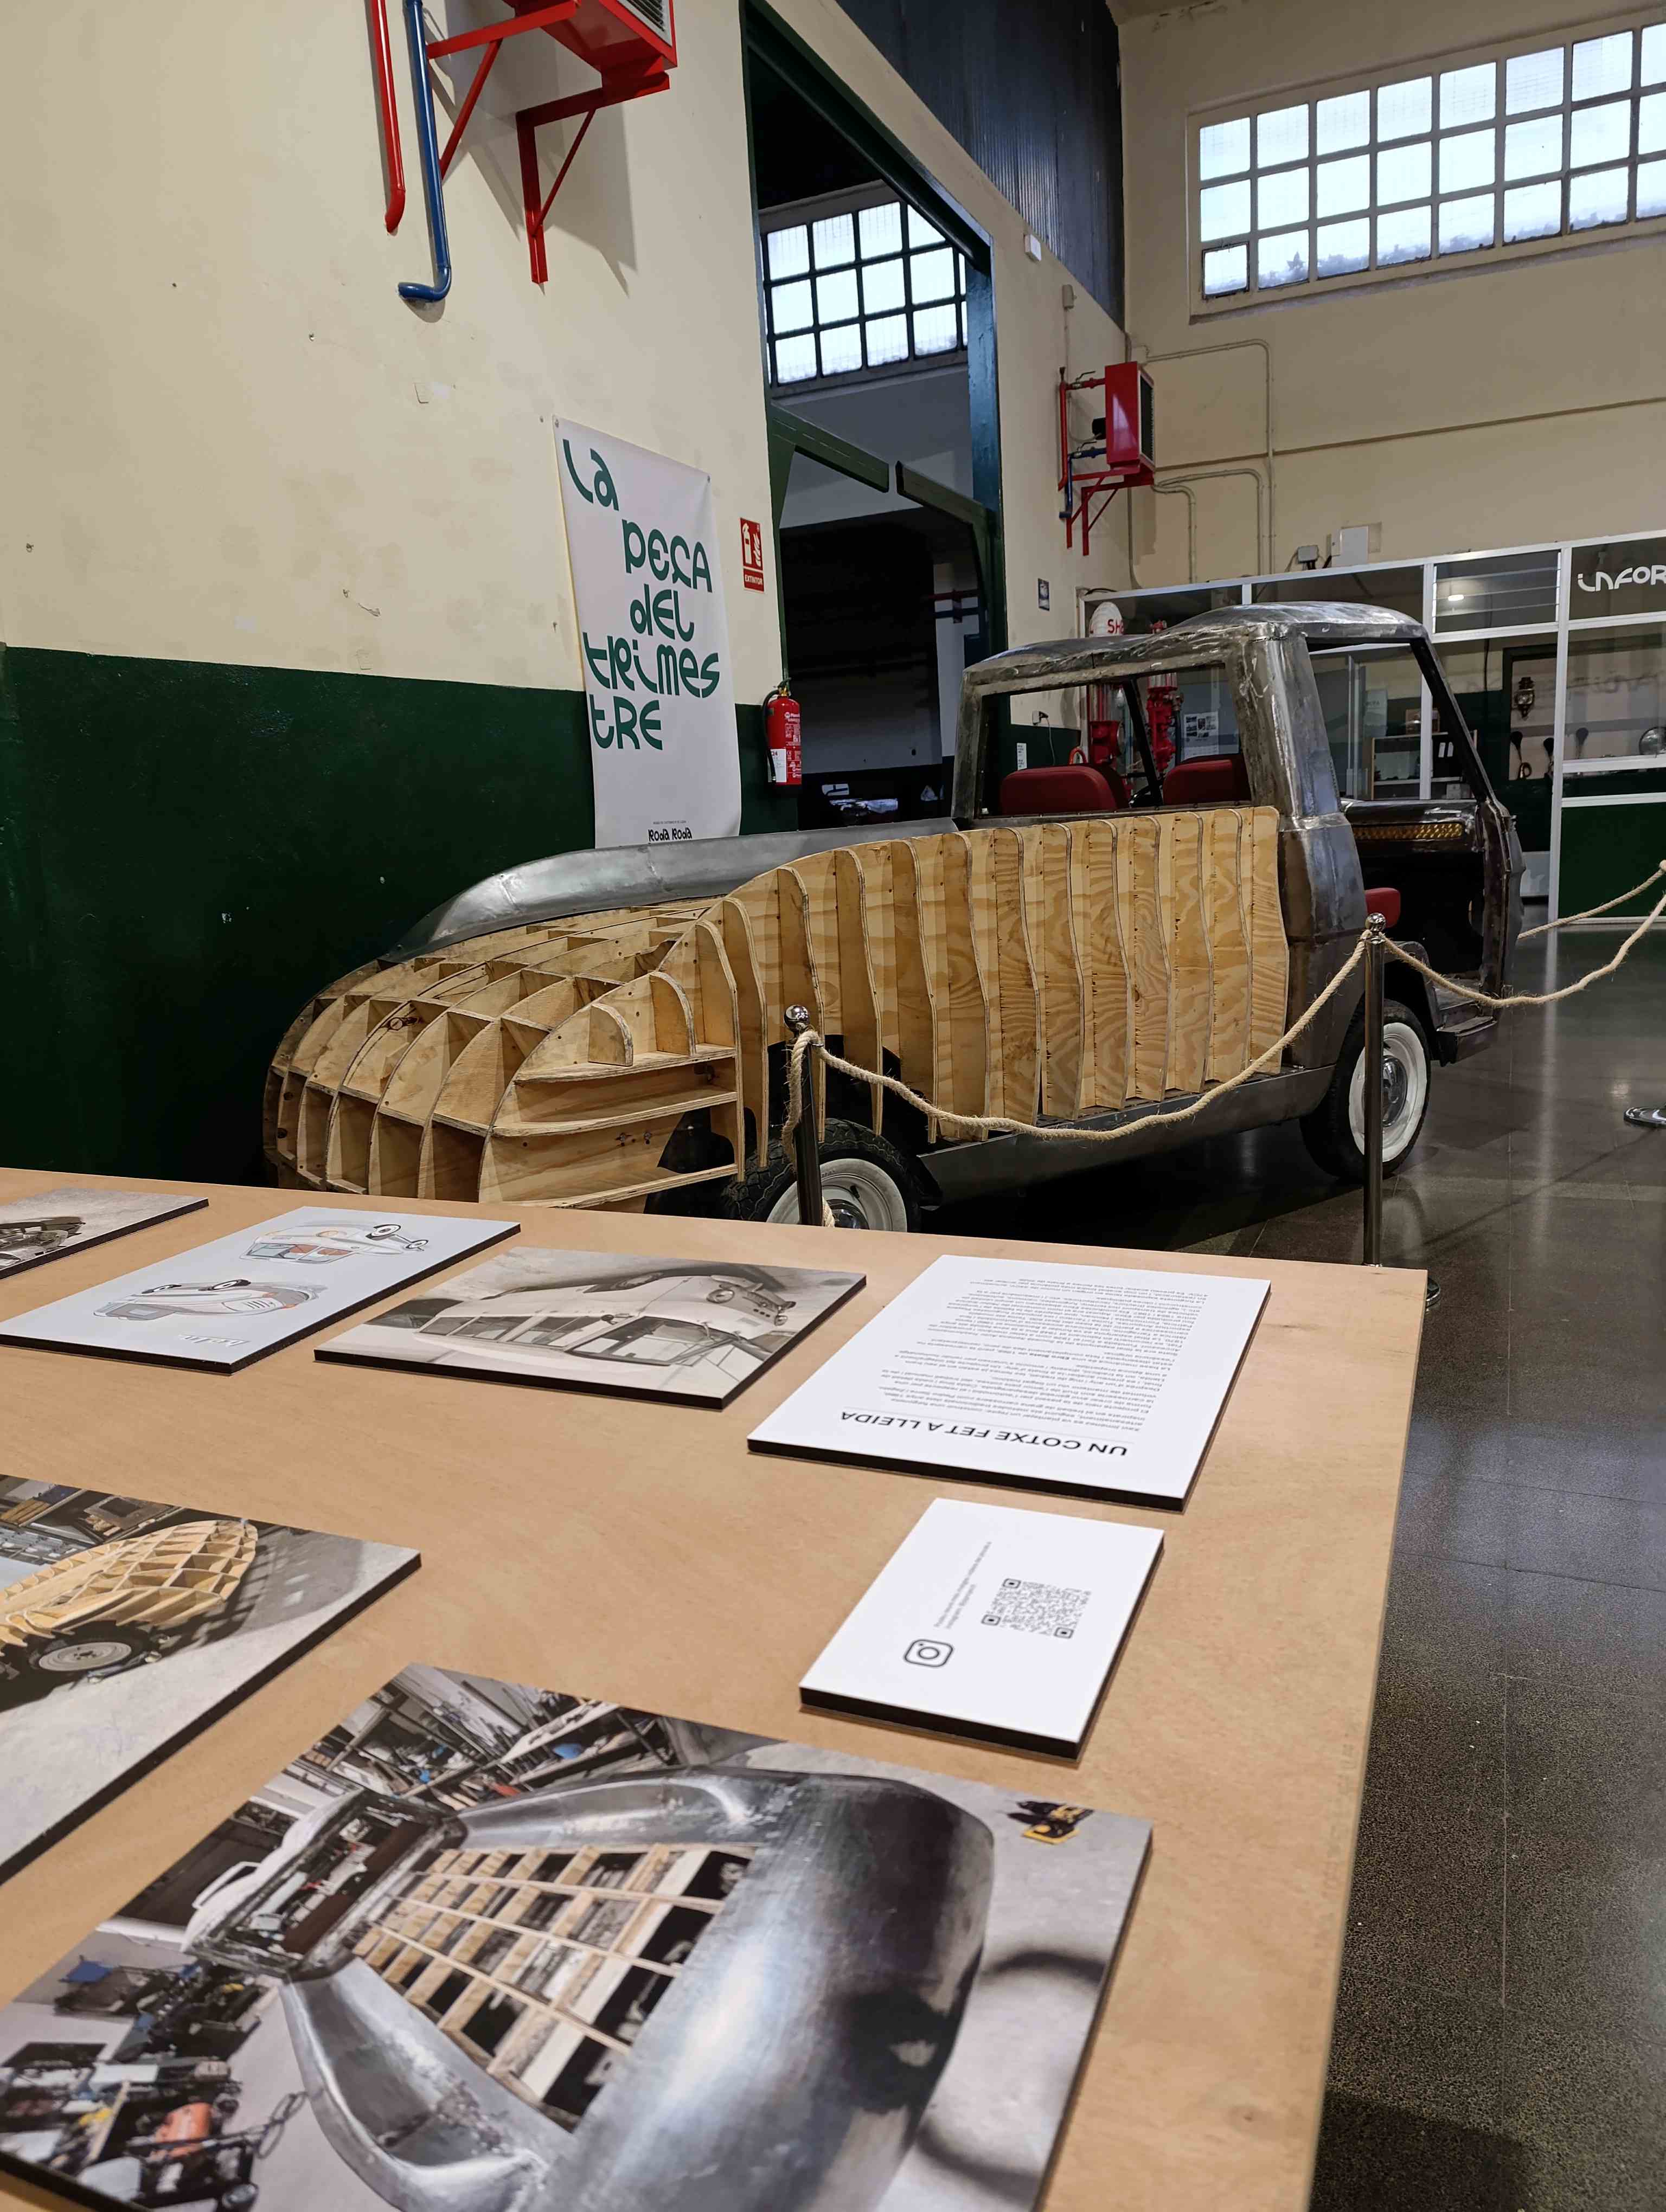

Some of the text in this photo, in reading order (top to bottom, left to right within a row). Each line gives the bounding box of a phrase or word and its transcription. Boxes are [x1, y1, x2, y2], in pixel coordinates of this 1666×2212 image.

[842, 1412, 1127, 1456] UN COTXE FET A LLEIDA
